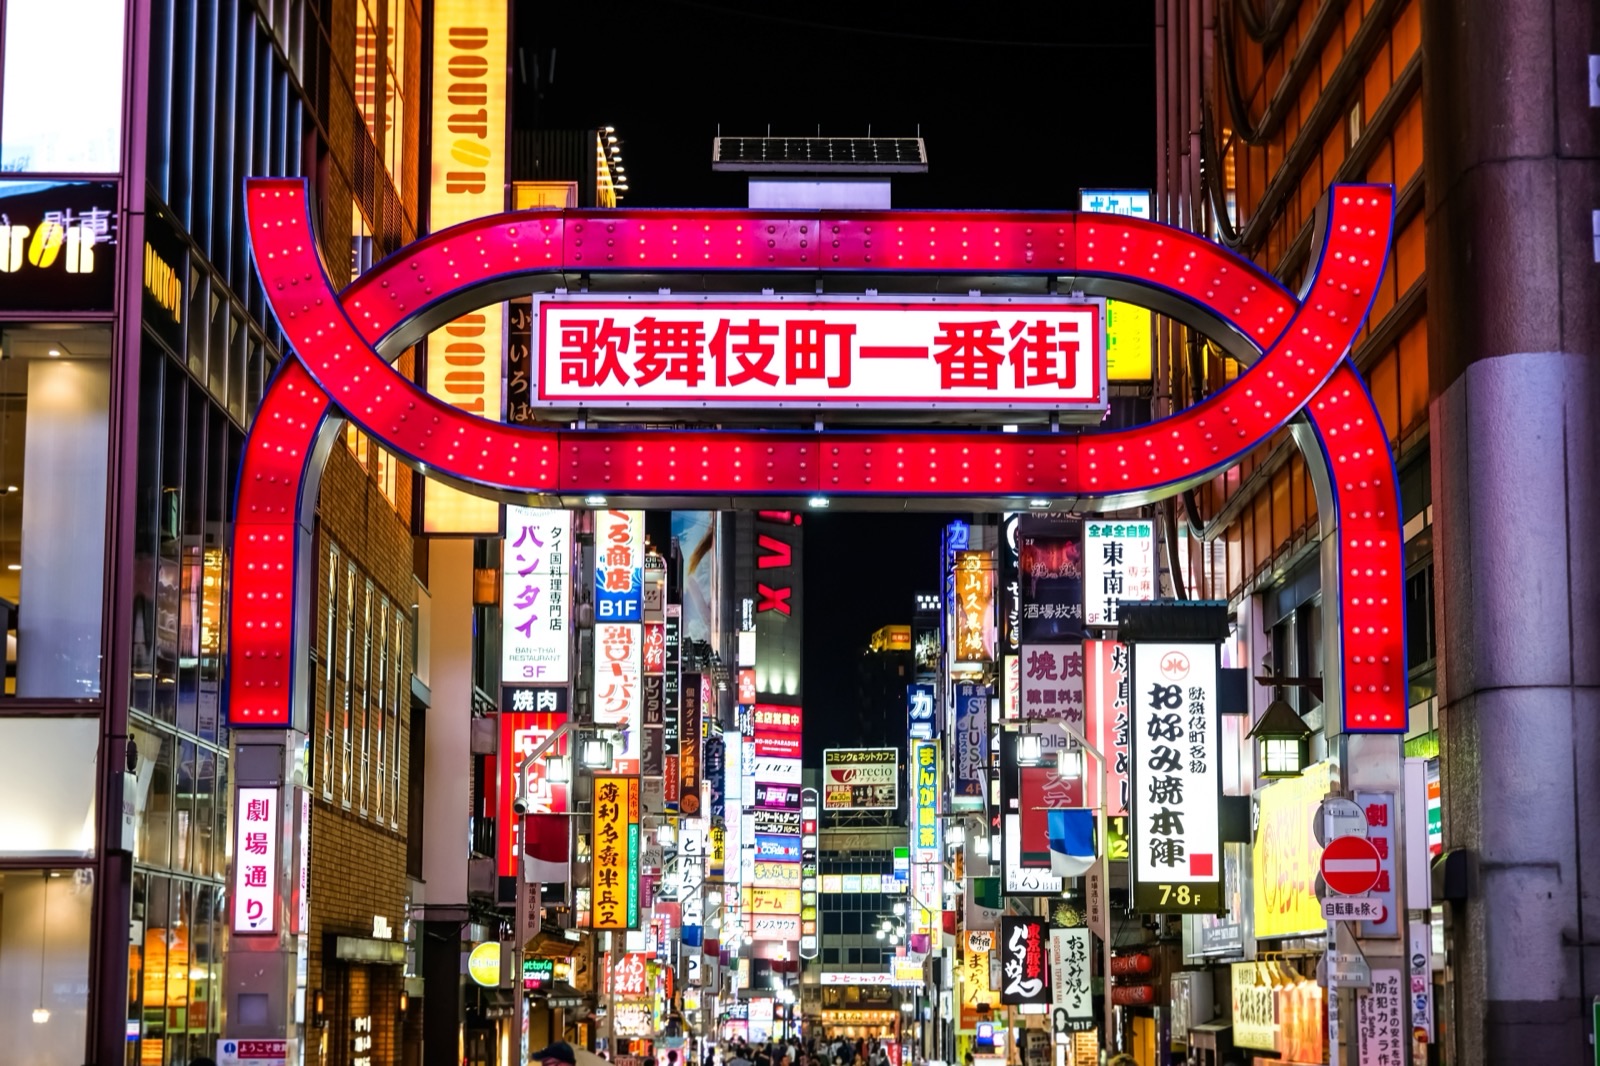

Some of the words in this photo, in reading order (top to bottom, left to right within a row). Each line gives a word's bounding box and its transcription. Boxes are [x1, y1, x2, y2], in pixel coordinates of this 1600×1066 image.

[446, 27, 491, 194] DOUTOR
[559, 317, 1080, 388] 歌舞伎町一番街
[1088, 524, 1150, 538] 全卓全自動
[512, 525, 544, 638] バンタイ
[549, 526, 562, 631] タイ国料理専門店
[1102, 541, 1124, 622] 東南荘
[1128, 567, 1139, 596] 専門
[599, 600, 638, 616] B1F
[1023, 604, 1081, 619] 酒場牧場
[1088, 613, 1100, 623] 3F
[522, 665, 547, 678] 3F
[962, 685, 986, 696] 麻雀
[513, 690, 557, 711] 焼肉
[647, 677, 660, 722] レンタル
[755, 710, 799, 727] 全店営業中
[685, 687, 694, 788] 個室ダイニング居酒屋
[1189, 687, 1206, 773] 歌舞伎町名物
[919, 747, 935, 847] まんが喫茶
[1147, 683, 1186, 868] お好み焼本陣
[245, 798, 269, 920] 劇場通り
[713, 829, 723, 860] 麻雀
[1091, 875, 1099, 923] 劇場通り一番街
[1325, 903, 1378, 916] 自転車を除く
[523, 960, 552, 970] attoria
[1026, 923, 1041, 978] 東京豚骨
[1065, 935, 1089, 1009] お好み焼き
[1073, 1021, 1092, 1030] B1F
[1361, 1027, 1369, 1056] Camera
[1375, 982, 1390, 1066] 防犯カメラ作
